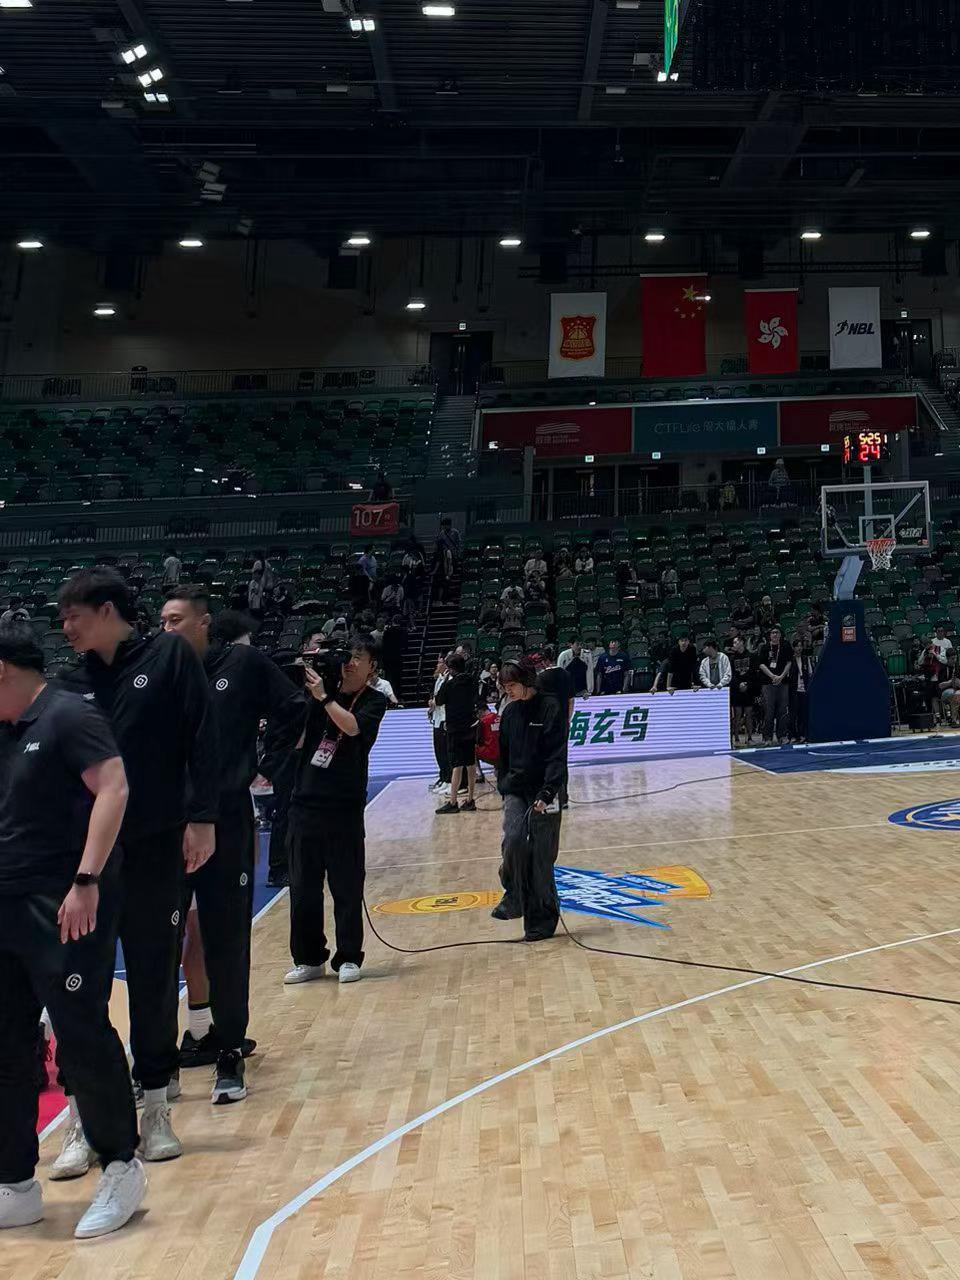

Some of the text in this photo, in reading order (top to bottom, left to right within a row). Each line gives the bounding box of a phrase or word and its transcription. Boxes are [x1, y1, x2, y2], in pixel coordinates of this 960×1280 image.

[848, 322, 875, 335] NBL
[860, 444, 880, 461] 24
[354, 510, 384, 527] 107
[569, 706, 650, 747] 海玄鸟
